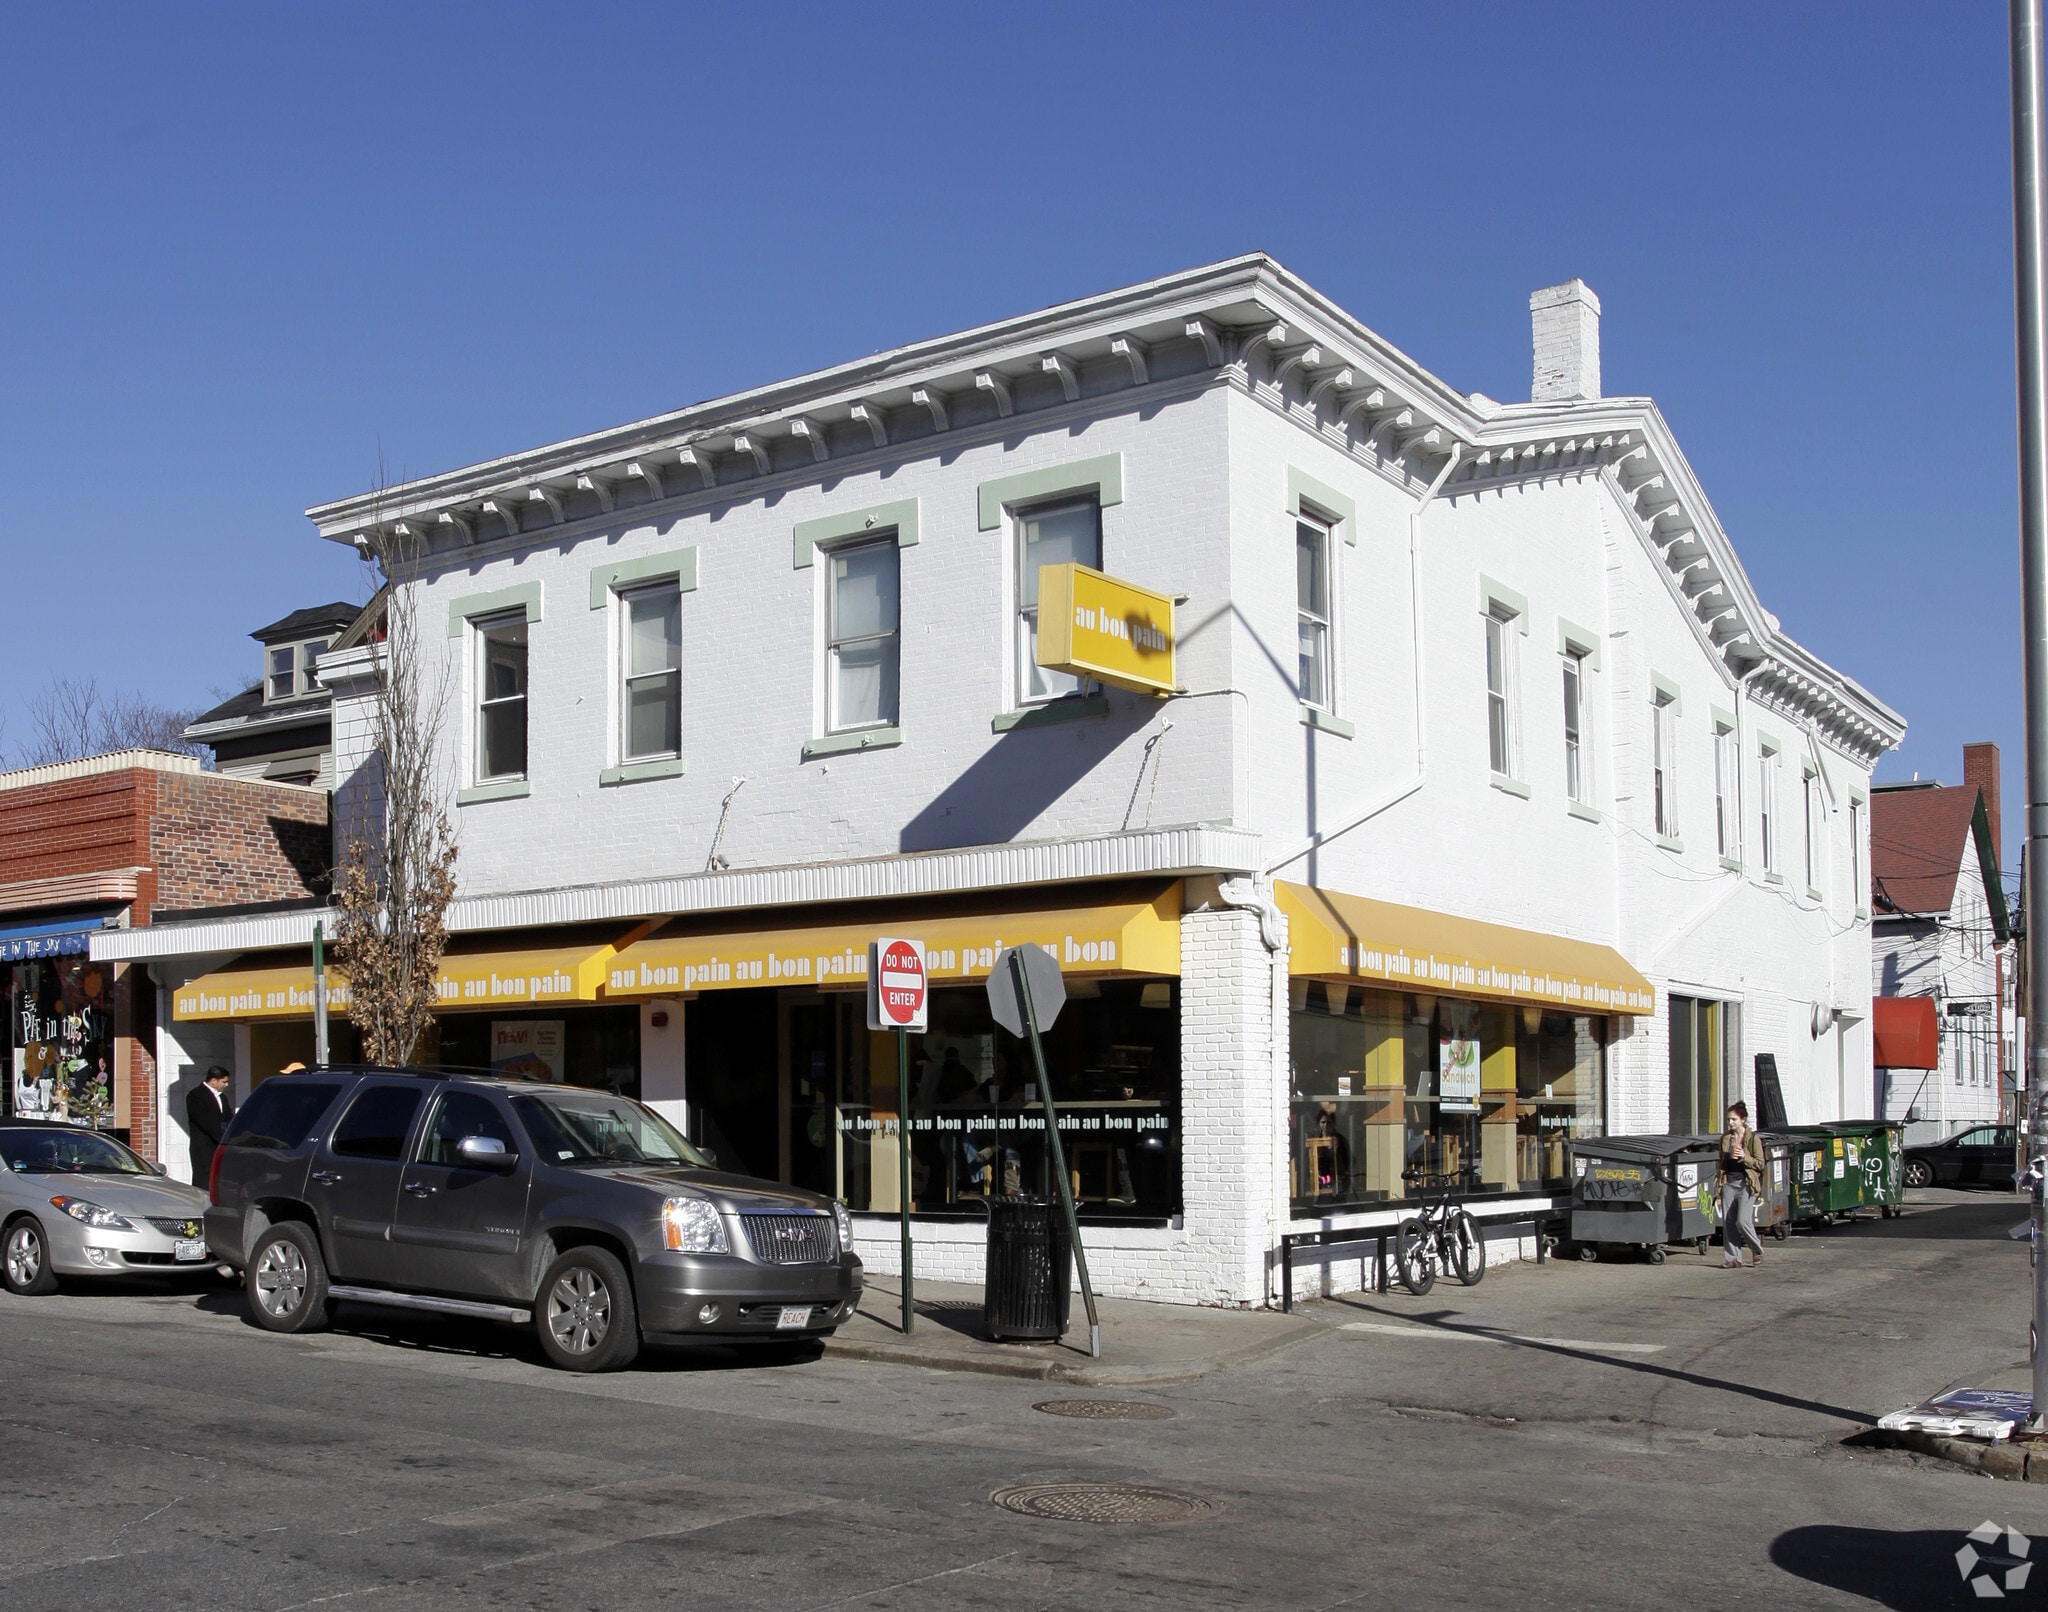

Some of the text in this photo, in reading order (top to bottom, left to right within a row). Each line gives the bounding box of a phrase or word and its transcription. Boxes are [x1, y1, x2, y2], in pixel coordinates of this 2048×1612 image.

[1075, 606, 1167, 652] au bon pain
[25, 940, 41, 956] THE
[611, 969, 636, 988] au
[641, 962, 679, 987] bon
[684, 956, 731, 990] pain
[736, 960, 763, 980] au
[768, 953, 811, 978] bon
[816, 948, 867, 983] pain
[927, 949, 955, 970] on
[1065, 935, 1117, 963] bon
[886, 954, 919, 969] DO NOT
[1341, 942, 1652, 1009] au bon pain au bon pain au bon pain au bon pain au bon pain au bon
[179, 997, 197, 1014] au
[200, 992, 226, 1013] bon
[229, 989, 262, 1016] pain
[266, 991, 286, 1008] au
[464, 979, 487, 998] au
[490, 973, 525, 996] bon
[530, 969, 572, 1000] pain
[889, 992, 916, 1006] ENTER
[46, 1017, 57, 1040] in
[857, 1115, 881, 1130] bon
[916, 1118, 932, 1130] au
[936, 1115, 962, 1130] bon
[966, 1114, 996, 1133] pain
[999, 1117, 1016, 1129] au
[1019, 1114, 1046, 1130] bon
[1058, 1114, 1080, 1130] ain
[1082, 1117, 1100, 1129] au
[1105, 1114, 1133, 1129] bon
[1136, 1113, 1169, 1132] pain
[775, 1228, 815, 1242] GMC
[782, 1311, 807, 1324] REACH
